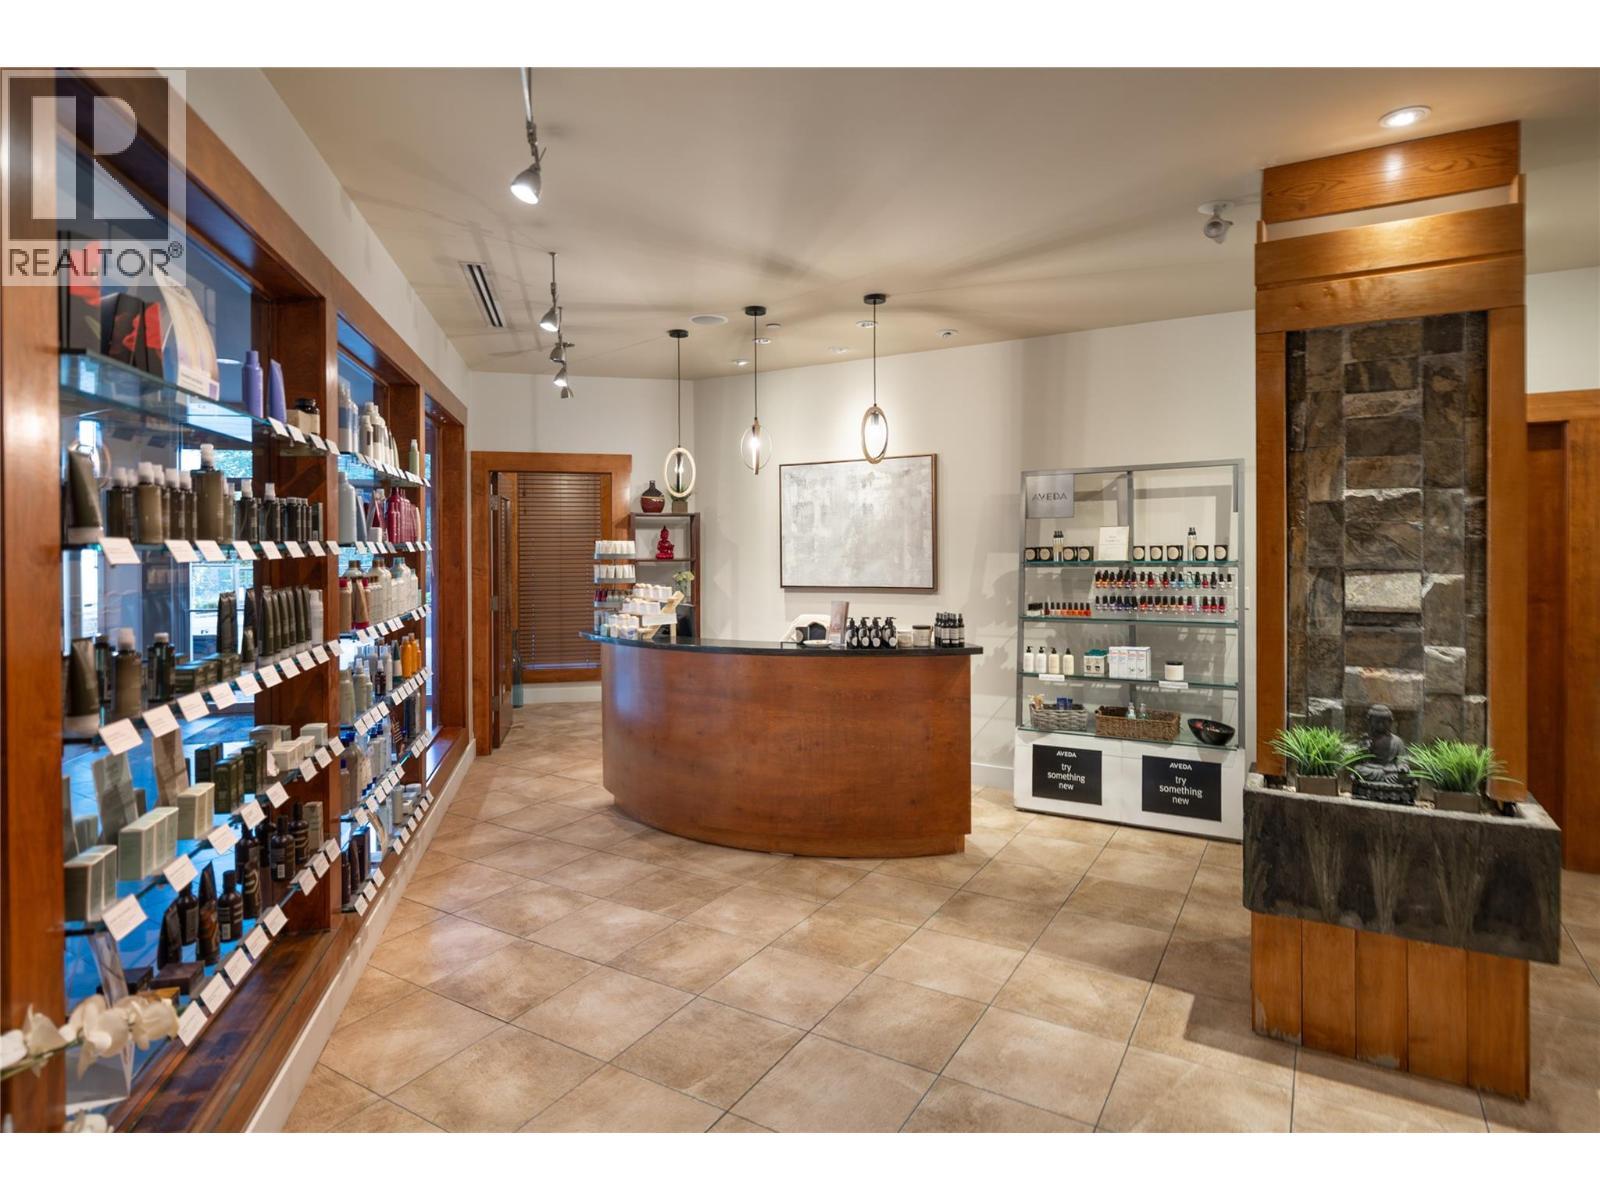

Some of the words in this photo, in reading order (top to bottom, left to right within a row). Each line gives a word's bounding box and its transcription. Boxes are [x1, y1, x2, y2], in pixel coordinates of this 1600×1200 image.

[1031, 492, 1068, 501] AVEDA
[1056, 750, 1077, 758] AVEDA
[1061, 763, 1072, 772] try
[1169, 762, 1192, 771] AVEDA
[1047, 771, 1086, 784] something
[1175, 776, 1187, 786] try
[1058, 782, 1074, 791] new
[1159, 784, 1203, 799] something
[1172, 796, 1190, 806] new
